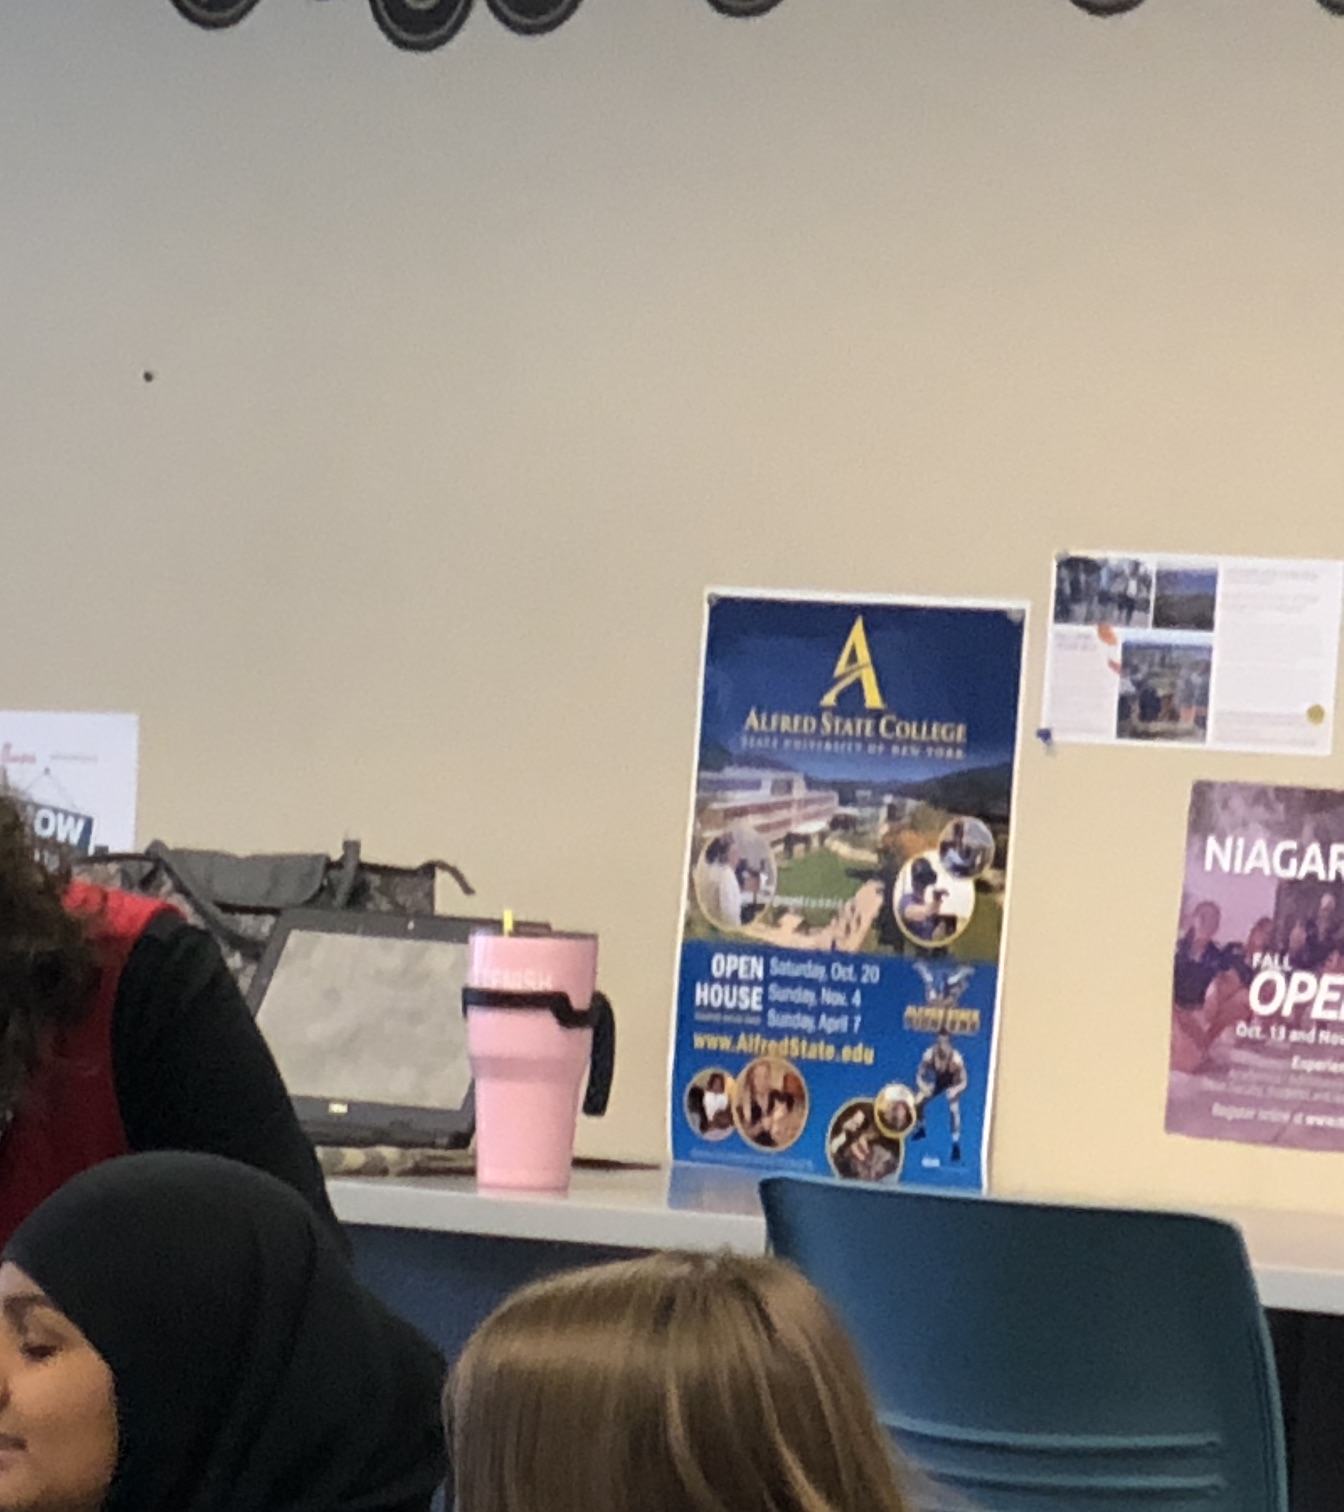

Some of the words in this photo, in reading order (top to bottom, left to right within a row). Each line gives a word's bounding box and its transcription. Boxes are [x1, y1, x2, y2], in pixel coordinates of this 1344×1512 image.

[712, 952, 764, 981] OPEN
[769, 956, 828, 982] Saturday,
[830, 962, 857, 982] Oct.
[860, 964, 881, 984] 20
[1252, 952, 1291, 971] FALL
[695, 981, 764, 1012] HOUSE
[767, 982, 817, 1010] Sunday,
[821, 986, 849, 1008] Nov.
[851, 988, 862, 1008] 4
[1248, 969, 1344, 1021] OPE
[766, 1007, 816, 1035] Sunday,
[818, 1012, 849, 1035] April
[853, 1013, 862, 1035] 7
[693, 1031, 876, 1066] www.AlfredState.edu
